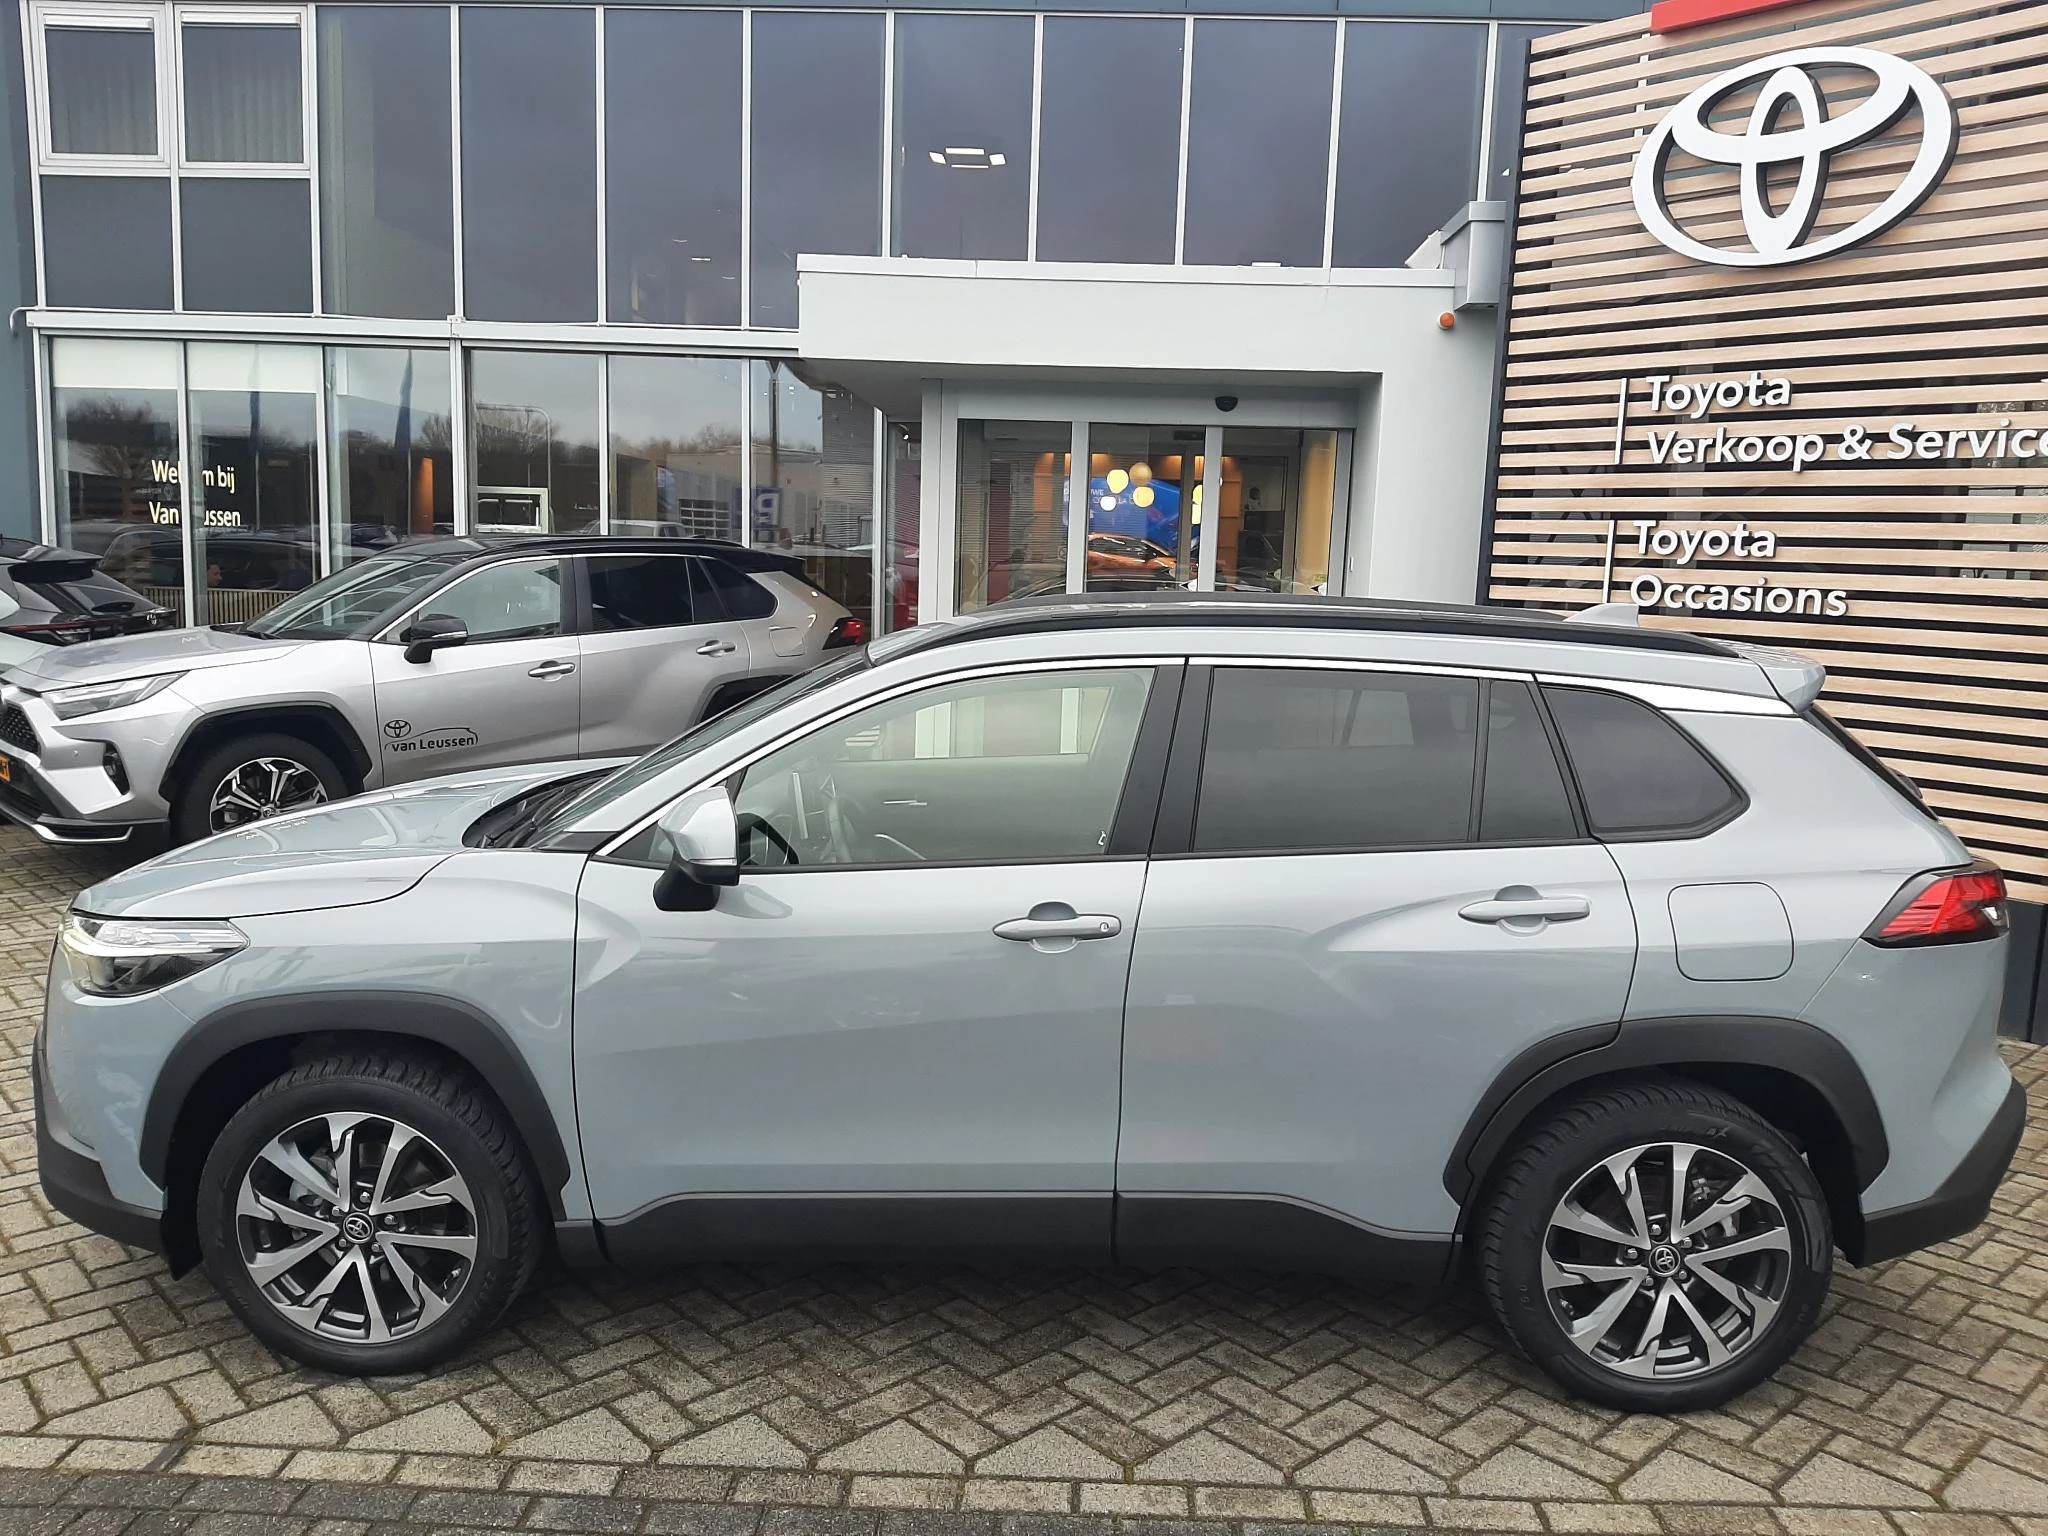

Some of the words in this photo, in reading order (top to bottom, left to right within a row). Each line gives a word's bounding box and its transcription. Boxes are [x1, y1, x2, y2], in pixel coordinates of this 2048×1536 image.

[1646, 372, 1792, 419] Toyota
[1648, 427, 1825, 472] Verkoop
[1838, 424, 1872, 461] &
[151, 459, 215, 487] Welm
[217, 465, 235, 494] bij
[149, 501, 180, 525] Van
[1633, 520, 1776, 565] Toyota
[1631, 574, 1848, 617] Occasions
[391, 741, 417, 752] van
[420, 736, 474, 750] Leussen
